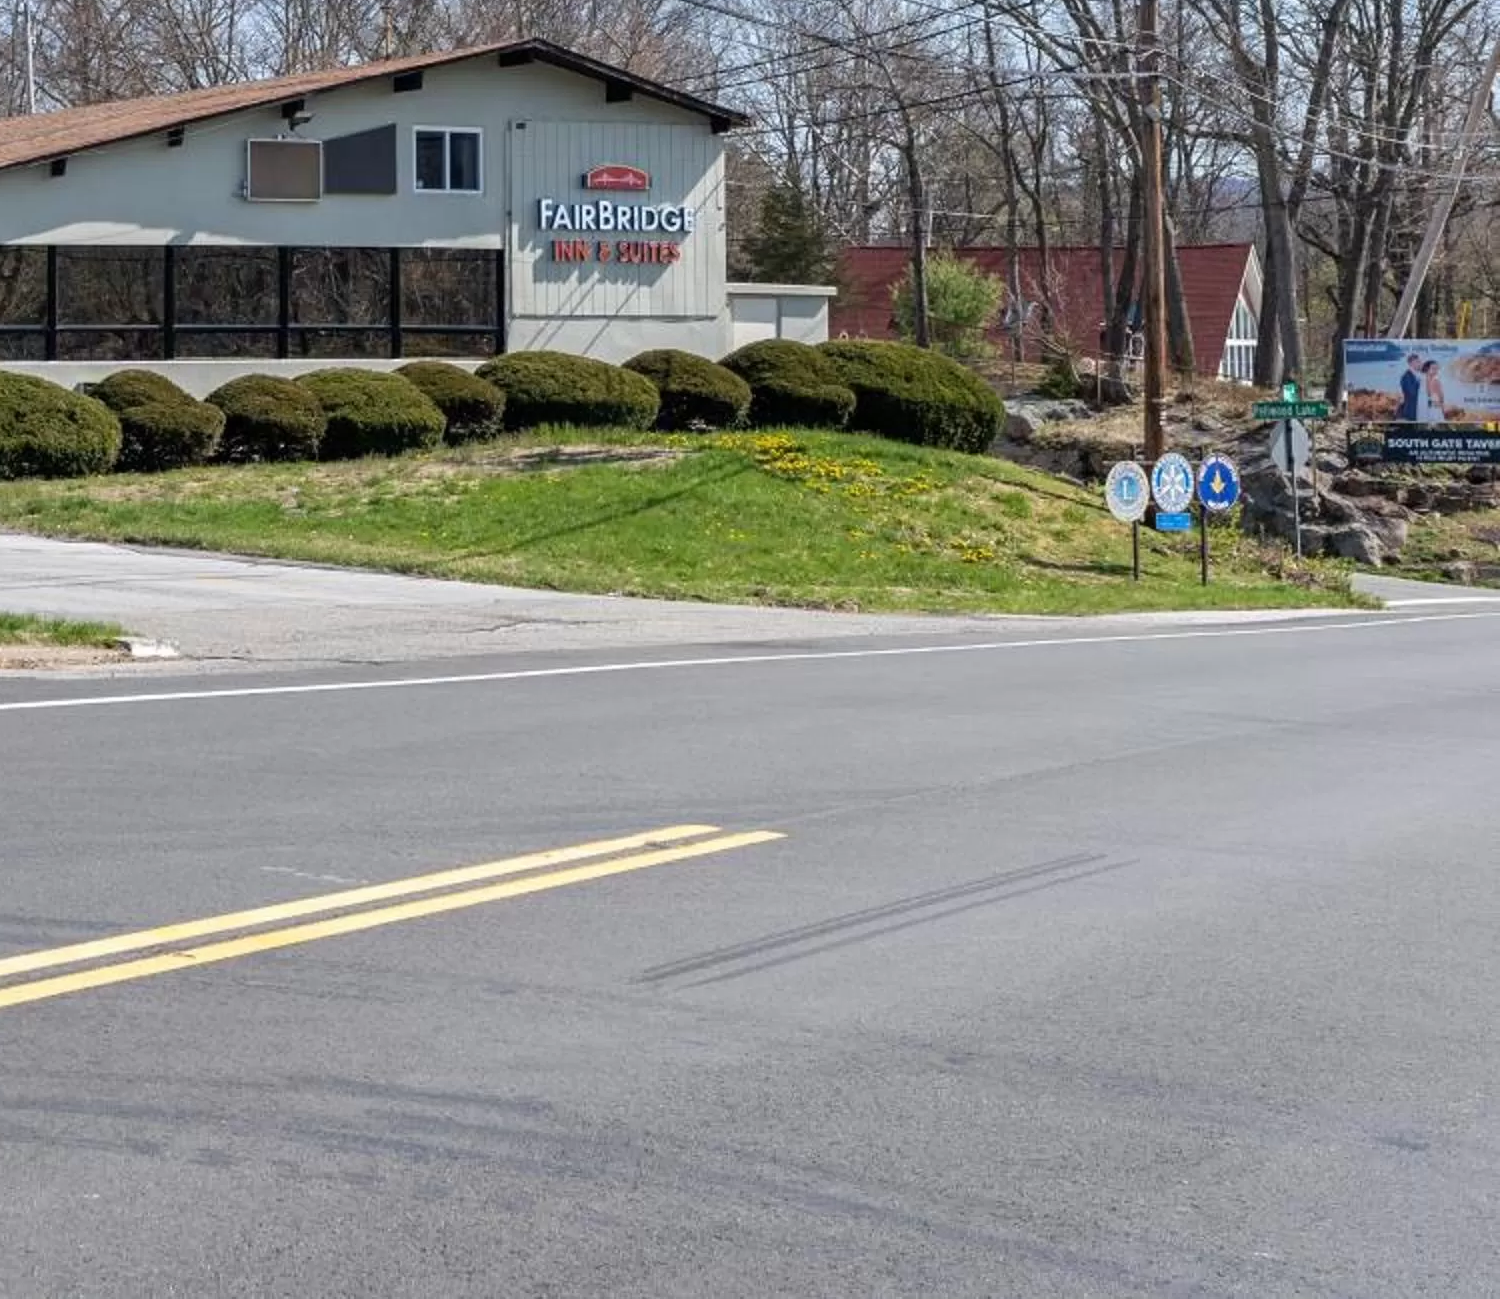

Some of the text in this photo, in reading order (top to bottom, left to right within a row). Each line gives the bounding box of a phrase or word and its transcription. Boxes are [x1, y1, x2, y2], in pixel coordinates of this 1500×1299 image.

[553, 239, 682, 265] INN & SUITES
[1388, 439, 1429, 448] SOUTH
[1431, 439, 1463, 448] GATE
